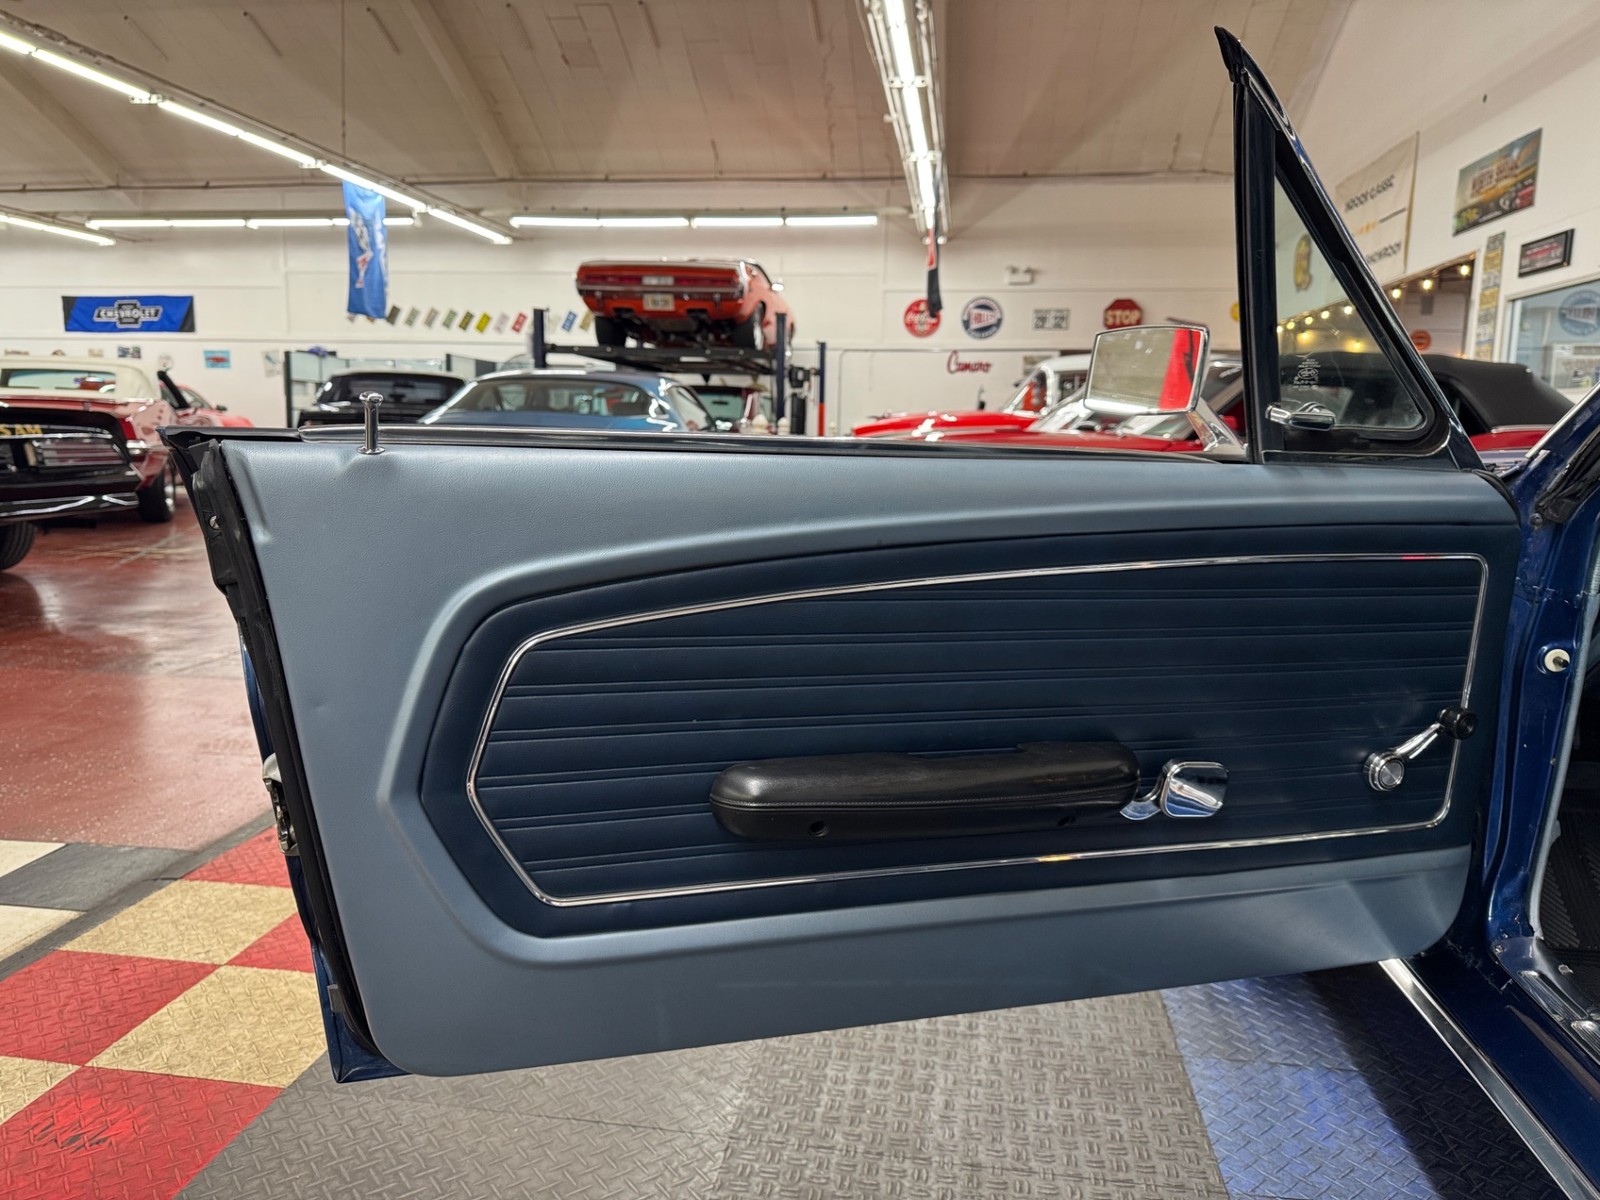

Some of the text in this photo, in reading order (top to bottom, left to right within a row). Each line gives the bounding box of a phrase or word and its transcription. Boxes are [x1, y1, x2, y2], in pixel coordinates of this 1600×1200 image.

[99, 308, 156, 318] CHEVROLET
[1106, 309, 1141, 326] STOP
[947, 350, 992, 374] Camaro
